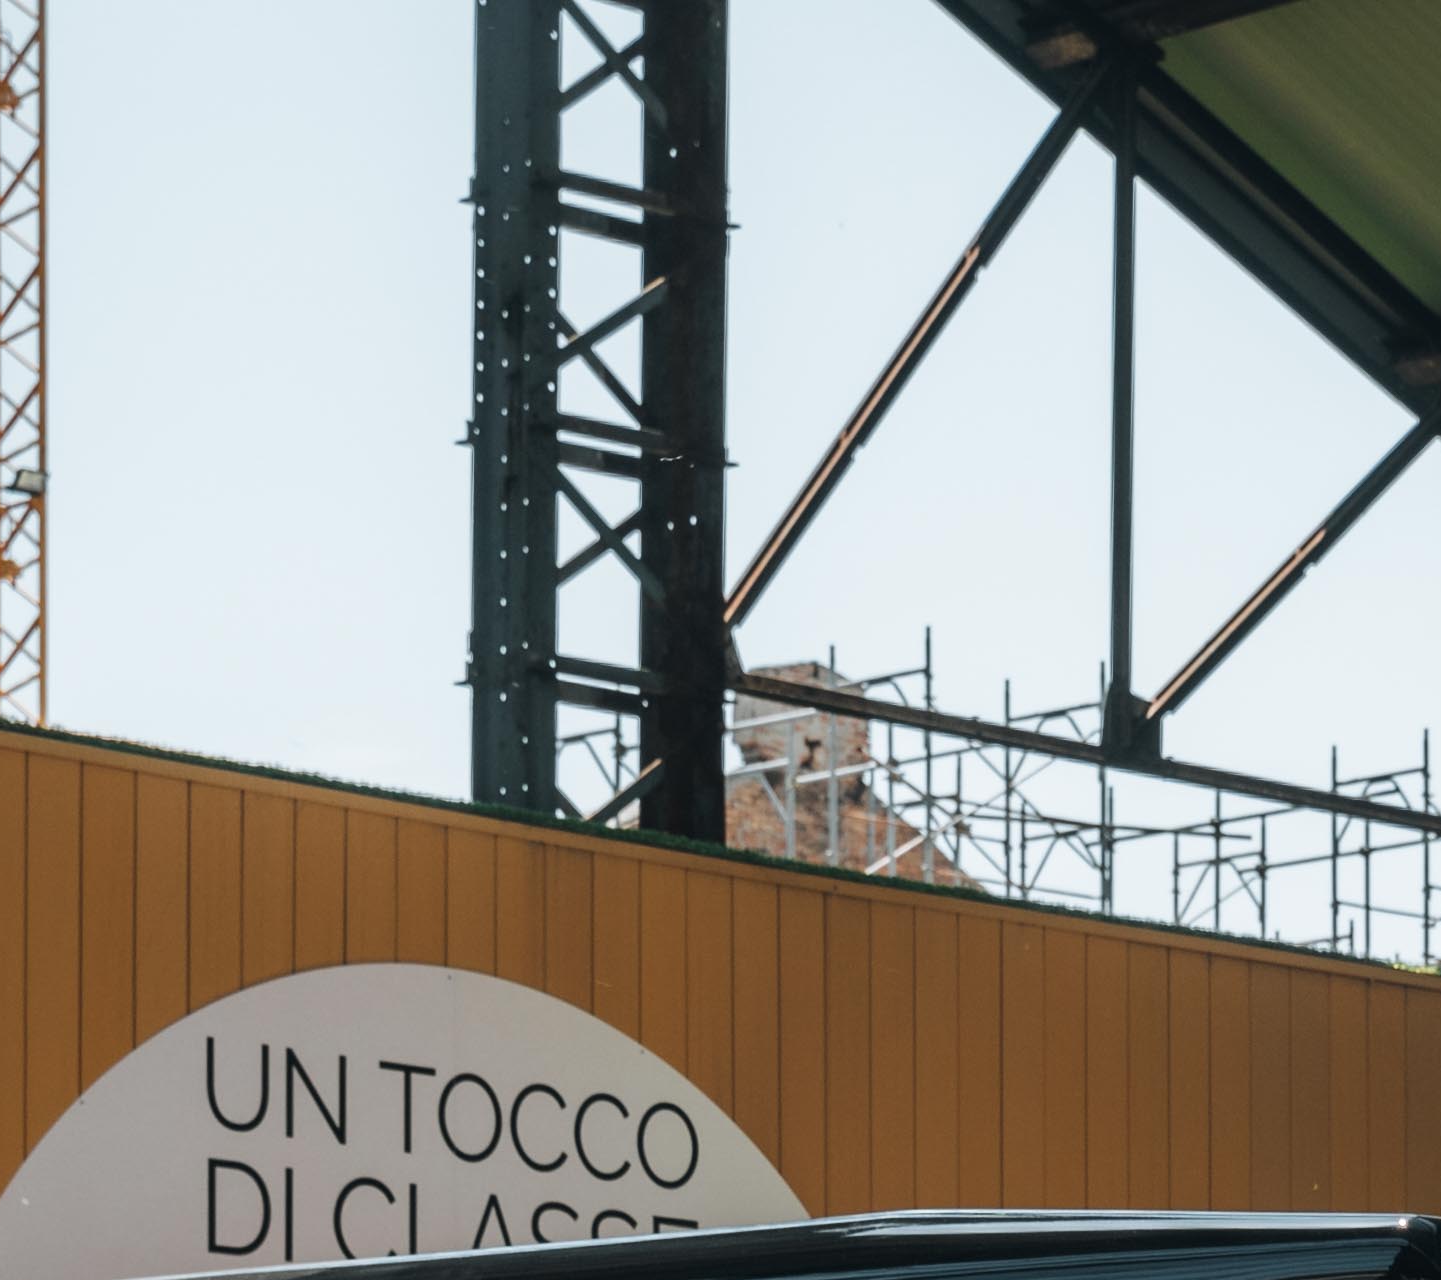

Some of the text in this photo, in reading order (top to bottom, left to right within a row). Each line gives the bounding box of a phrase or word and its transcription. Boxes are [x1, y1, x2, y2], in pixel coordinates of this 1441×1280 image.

[206, 1036, 699, 1190] UN TOCCO
[207, 1157, 294, 1263] DI
